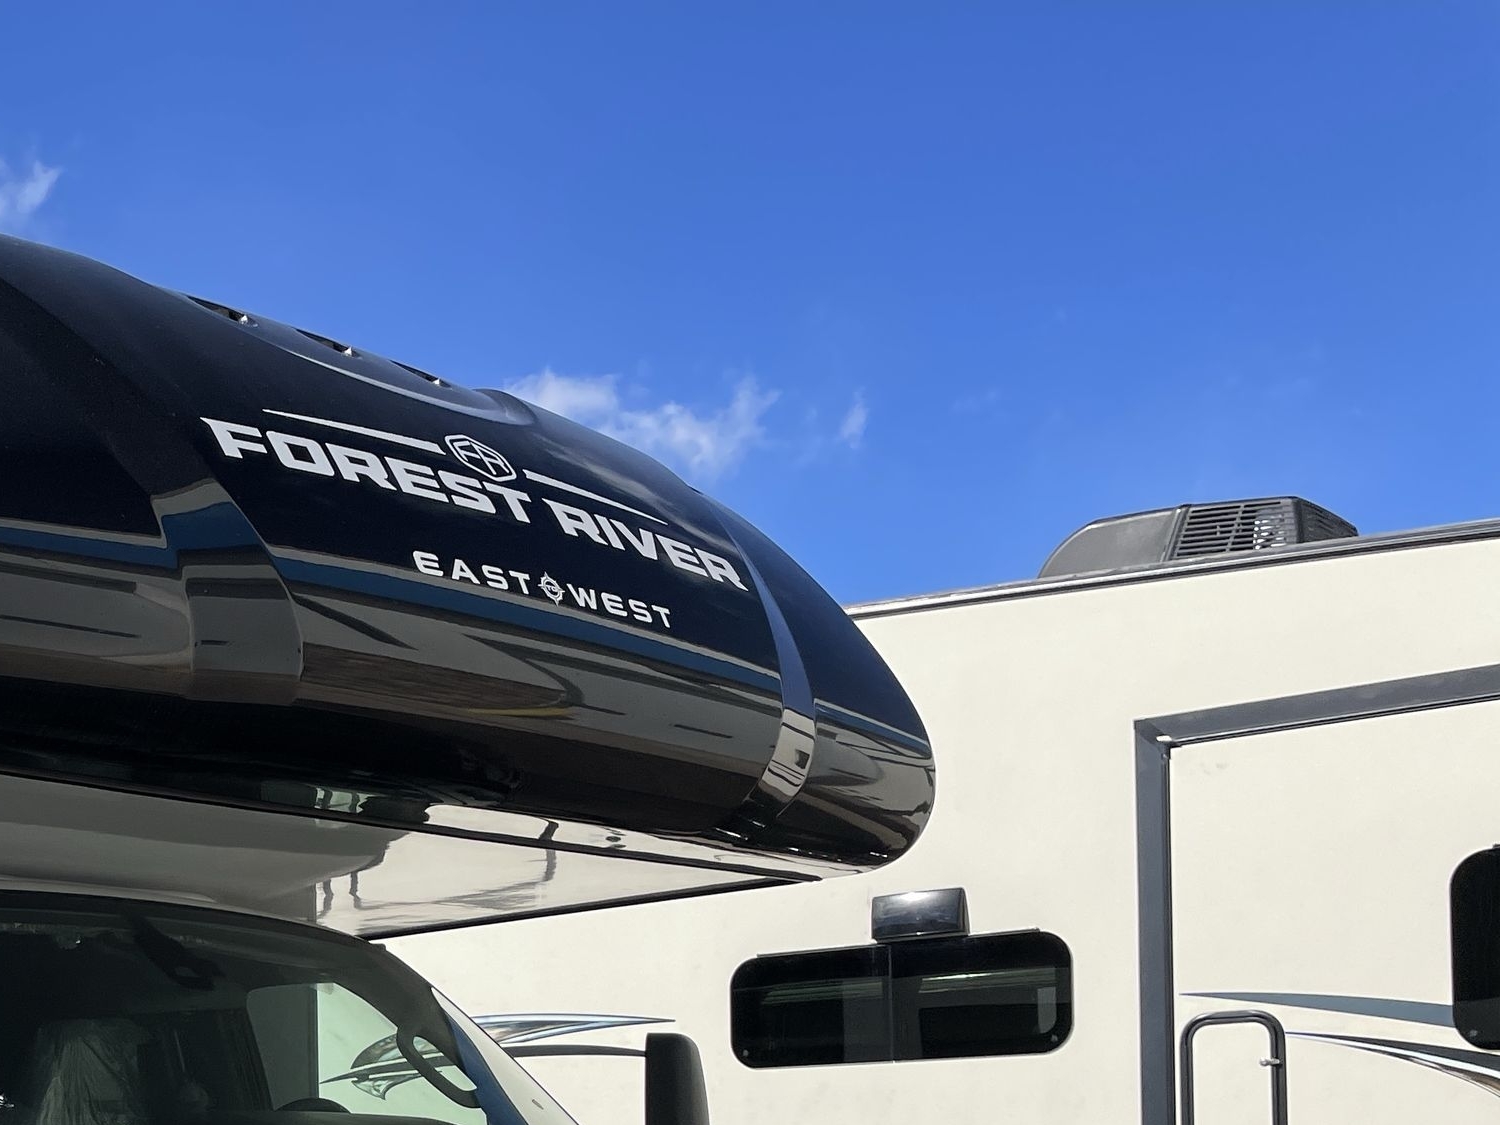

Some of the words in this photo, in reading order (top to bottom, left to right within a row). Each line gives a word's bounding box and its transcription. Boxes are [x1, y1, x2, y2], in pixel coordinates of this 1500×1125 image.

[200, 417, 532, 524] FOREST
[541, 498, 749, 592] RIVER
[413, 550, 530, 595] EAST
[566, 583, 671, 629] WEST
